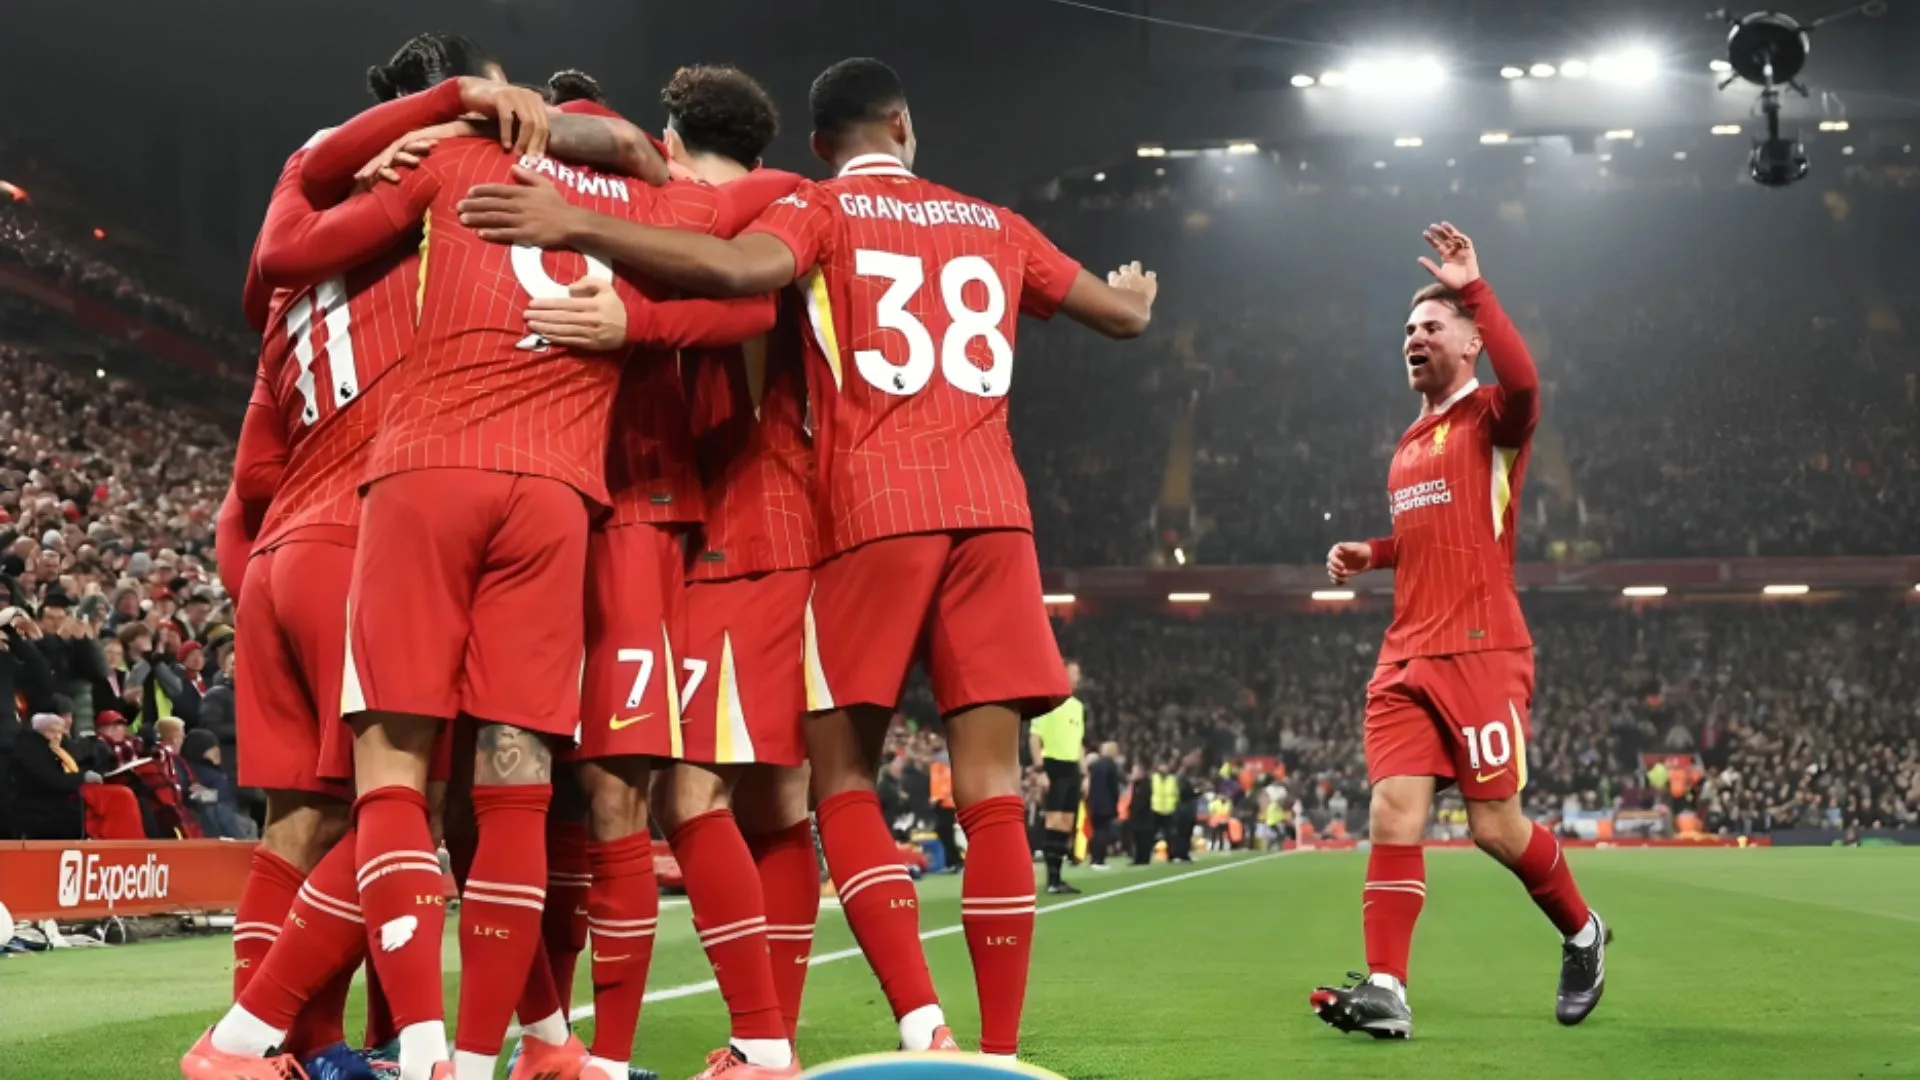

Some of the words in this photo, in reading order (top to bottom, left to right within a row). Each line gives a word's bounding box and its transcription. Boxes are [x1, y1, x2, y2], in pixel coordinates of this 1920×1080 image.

[839, 193, 1001, 231] GRAVENBERCH
[286, 274, 361, 427] 11
[854, 248, 1013, 397] 38
[617, 649, 654, 708] 7
[1462, 721, 1510, 769] 10
[84, 852, 169, 910] Expedia
[415, 894, 443, 907] LFC
